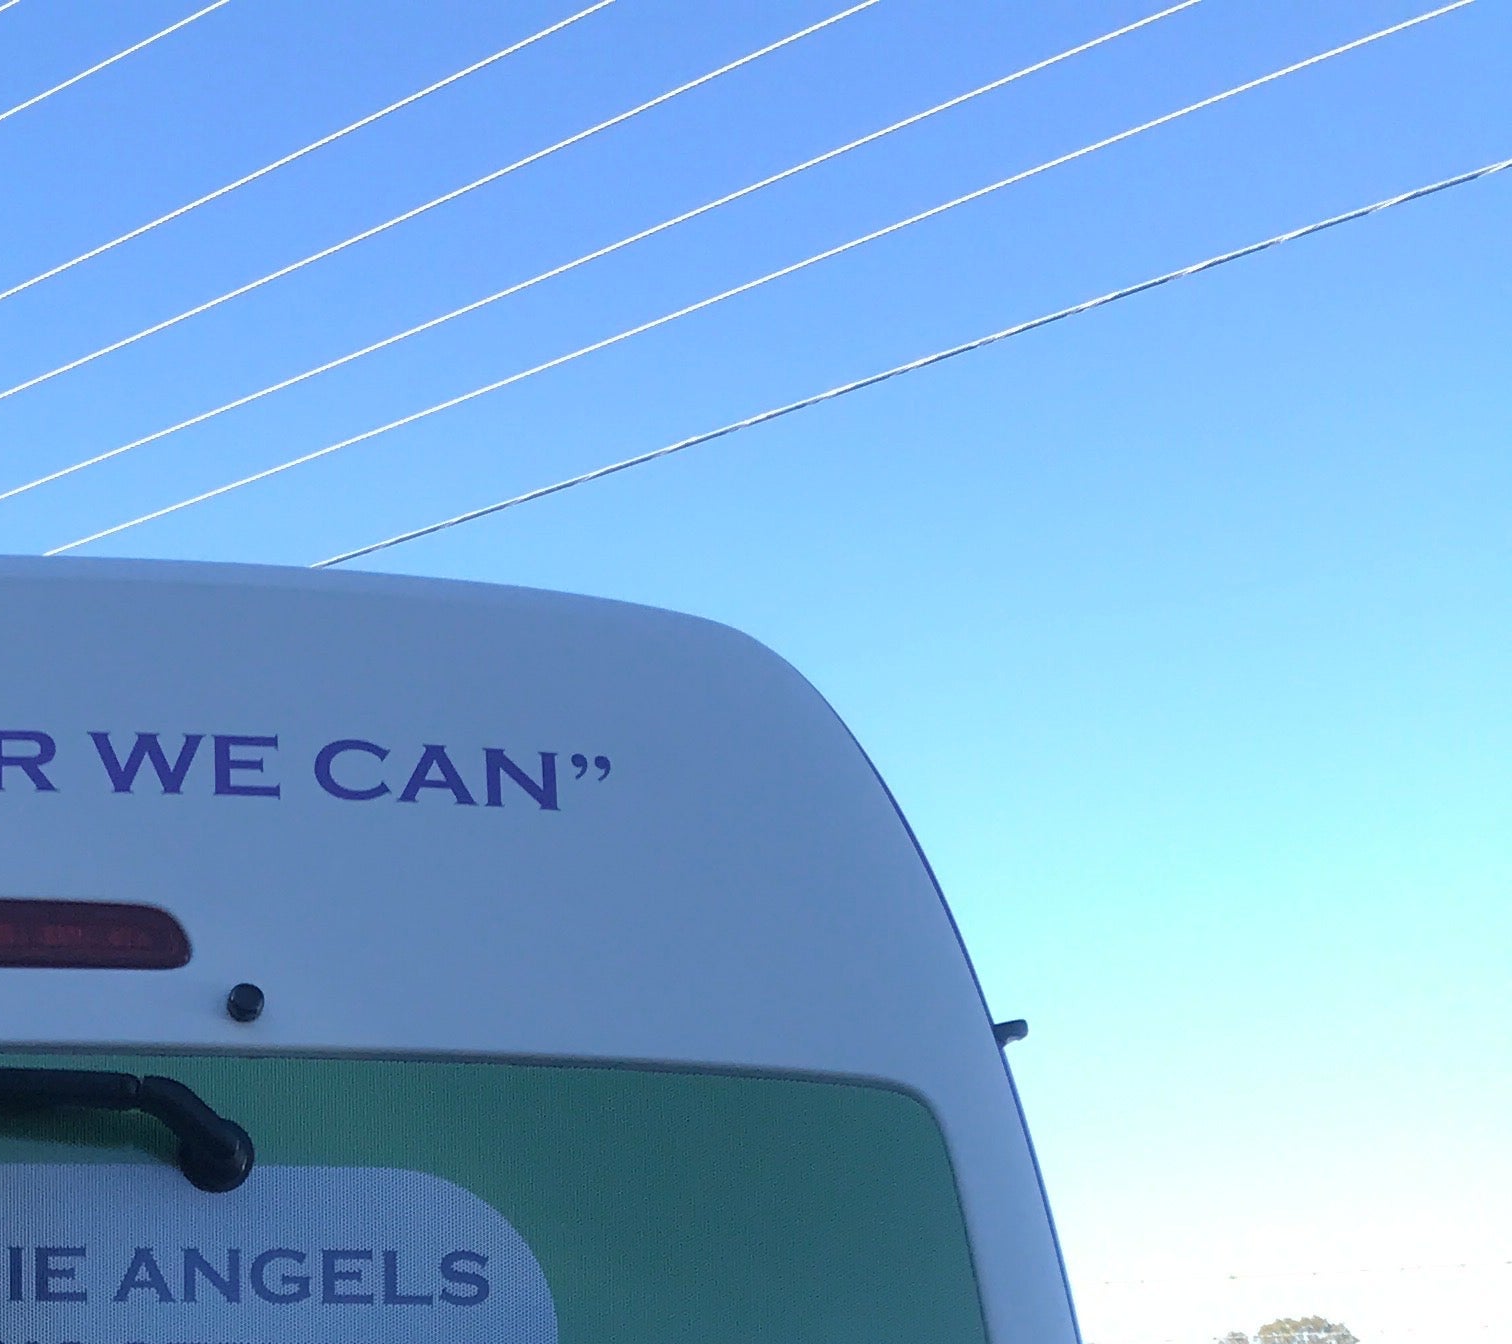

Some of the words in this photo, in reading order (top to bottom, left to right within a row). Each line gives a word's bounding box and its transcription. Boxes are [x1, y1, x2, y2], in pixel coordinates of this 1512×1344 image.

[87, 731, 282, 800] WE
[314, 739, 612, 812] CAN”
[112, 1246, 491, 1307] ANGELS
